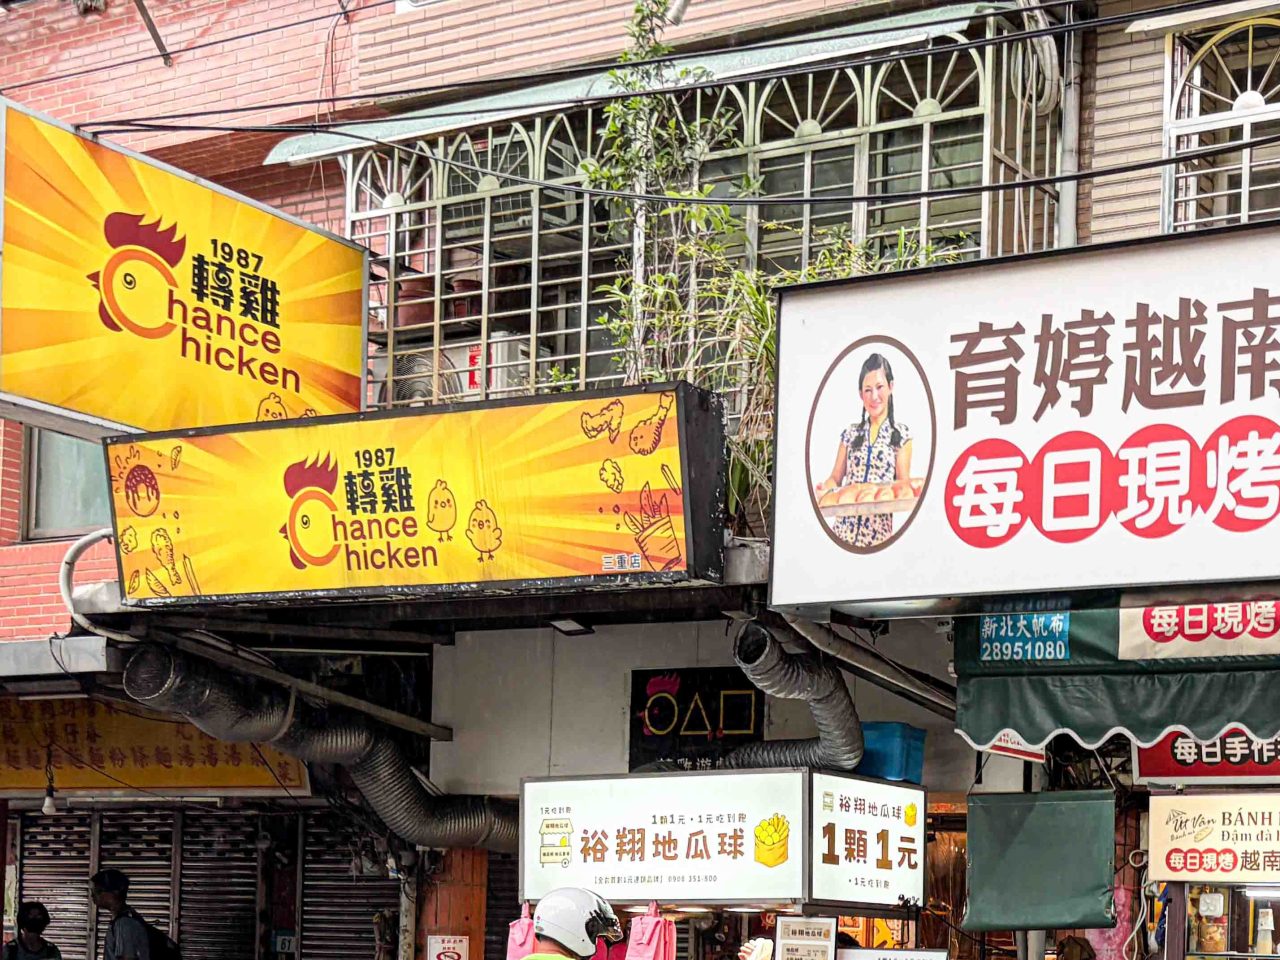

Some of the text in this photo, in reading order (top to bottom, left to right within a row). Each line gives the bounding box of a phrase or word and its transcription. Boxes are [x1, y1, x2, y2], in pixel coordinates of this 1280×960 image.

[209, 236, 264, 273] 1987
[190, 251, 281, 330] 轉雞
[353, 447, 396, 469] 1987
[345, 466, 415, 516] 轉雞
[601, 553, 642, 571] 三重店
[981, 612, 1065, 639] 新北大帆布
[1150, 601, 1276, 637] 每日現烤
[981, 640, 1065, 662] 28951080
[838, 794, 902, 820] 裕翔地瓜球
[1221, 808, 1273, 827] BÁNH
[579, 826, 746, 863] 裕翔地瓜球
[821, 822, 918, 870] 1顆1元
[1221, 829, 1252, 845] Đậm
[1256, 829, 1272, 843] đà
[1168, 851, 1236, 871] 每日現烤
